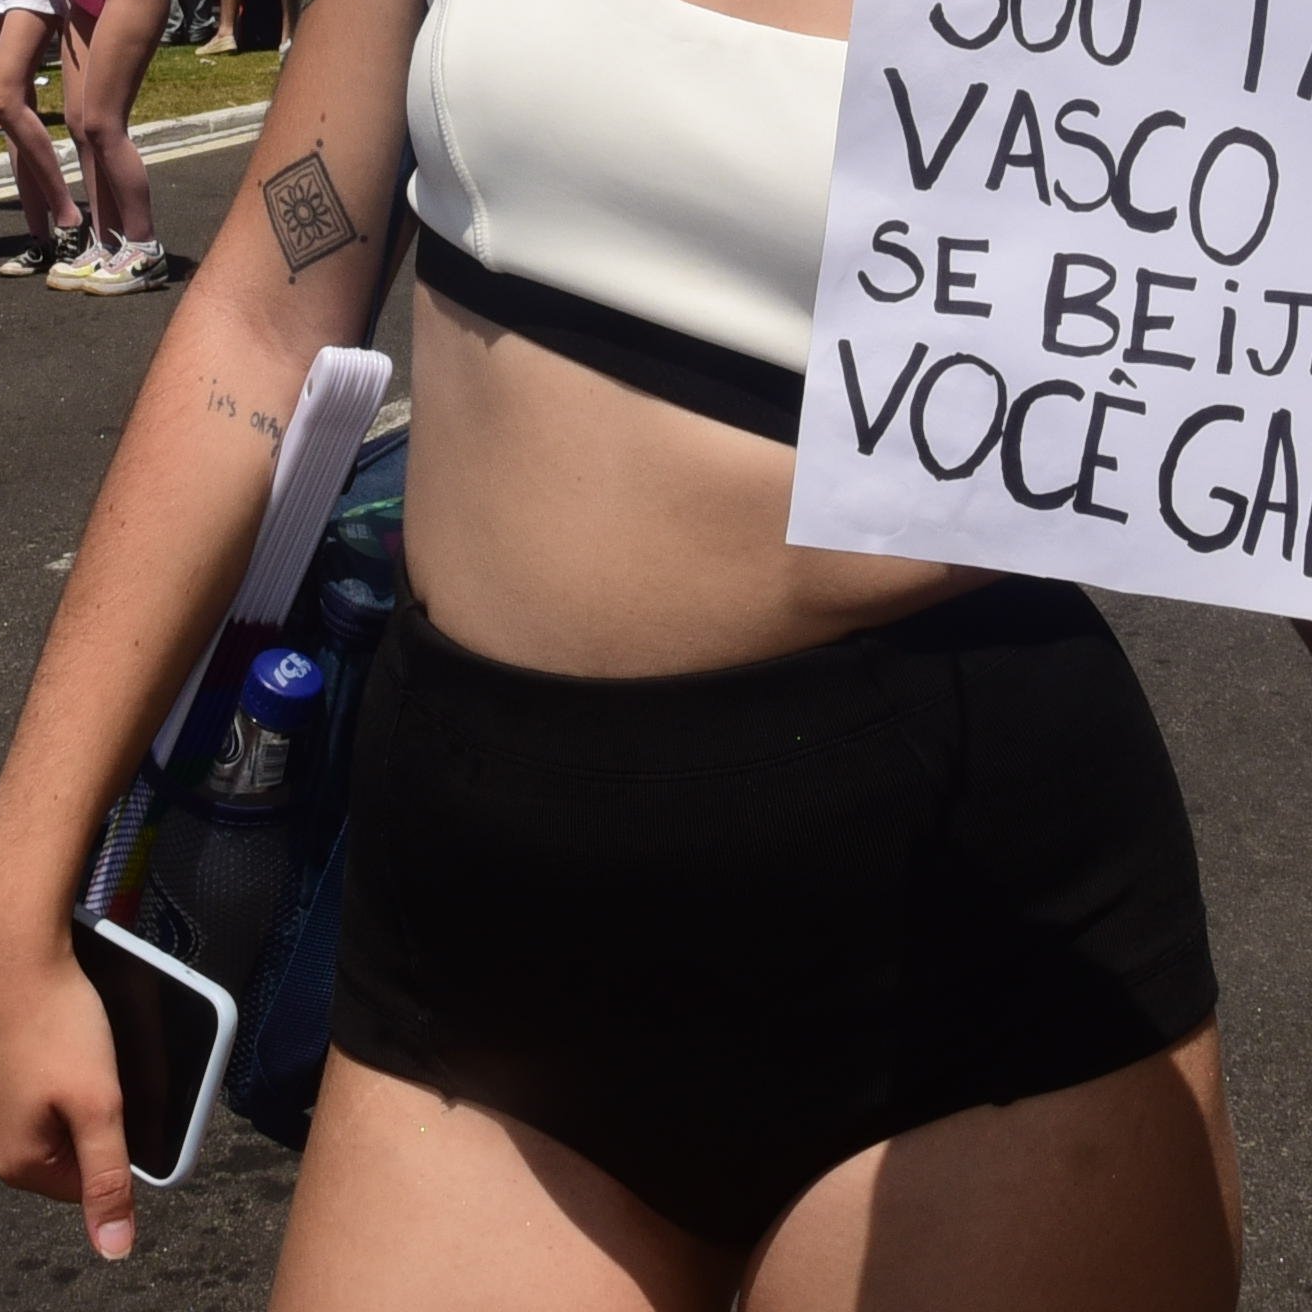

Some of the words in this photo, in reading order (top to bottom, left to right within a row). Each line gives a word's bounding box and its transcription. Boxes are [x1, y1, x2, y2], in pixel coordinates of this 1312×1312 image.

[884, 68, 1278, 266] VASCO
[858, 221, 991, 317] SE
[839, 340, 1145, 524] VOCÊ
